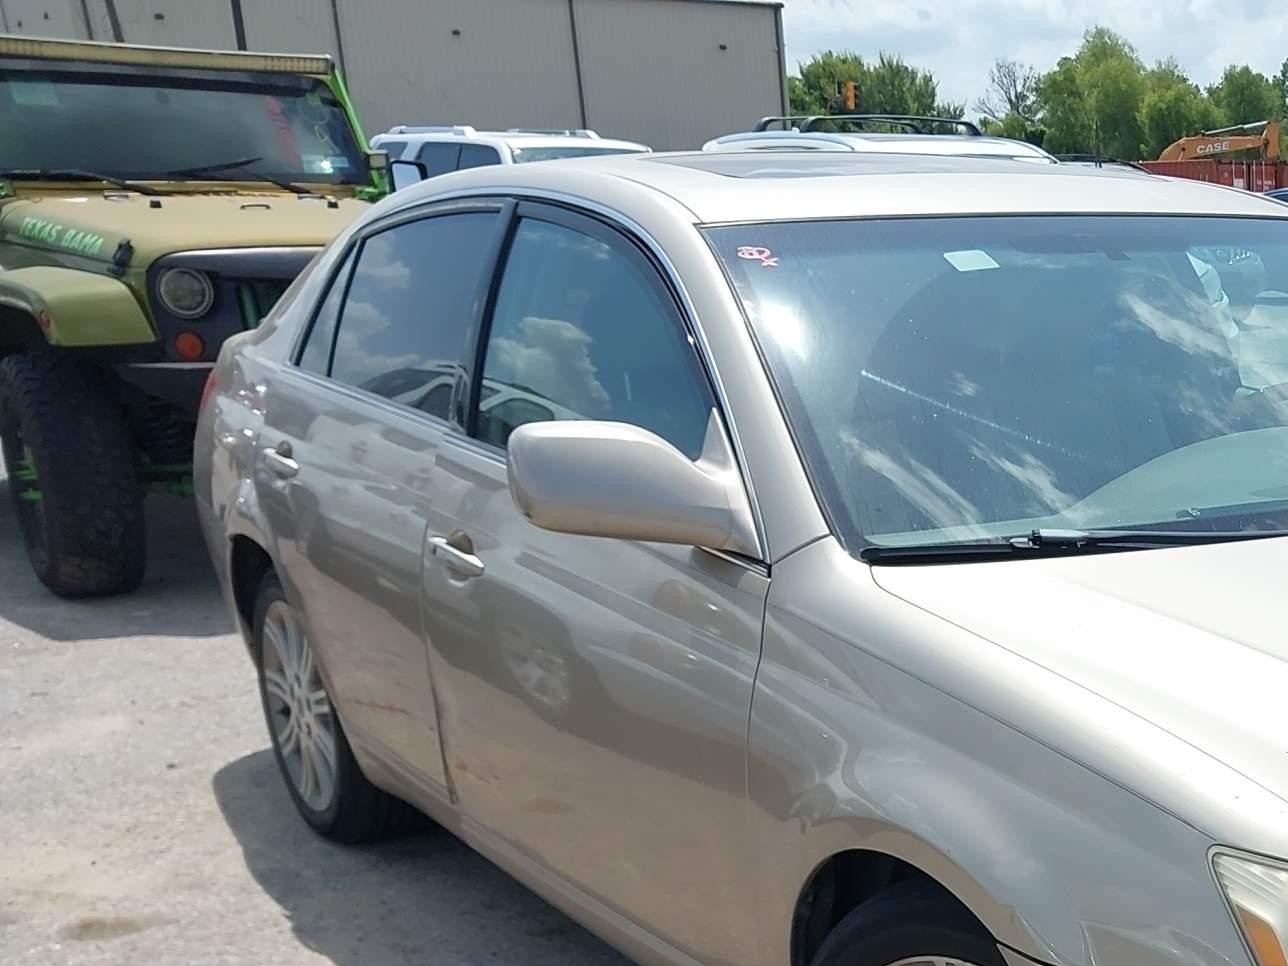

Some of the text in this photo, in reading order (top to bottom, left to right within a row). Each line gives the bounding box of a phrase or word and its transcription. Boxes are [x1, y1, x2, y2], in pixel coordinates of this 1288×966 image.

[1196, 141, 1230, 154] CASE
[20, 217, 104, 255] TEXAS BAMA
